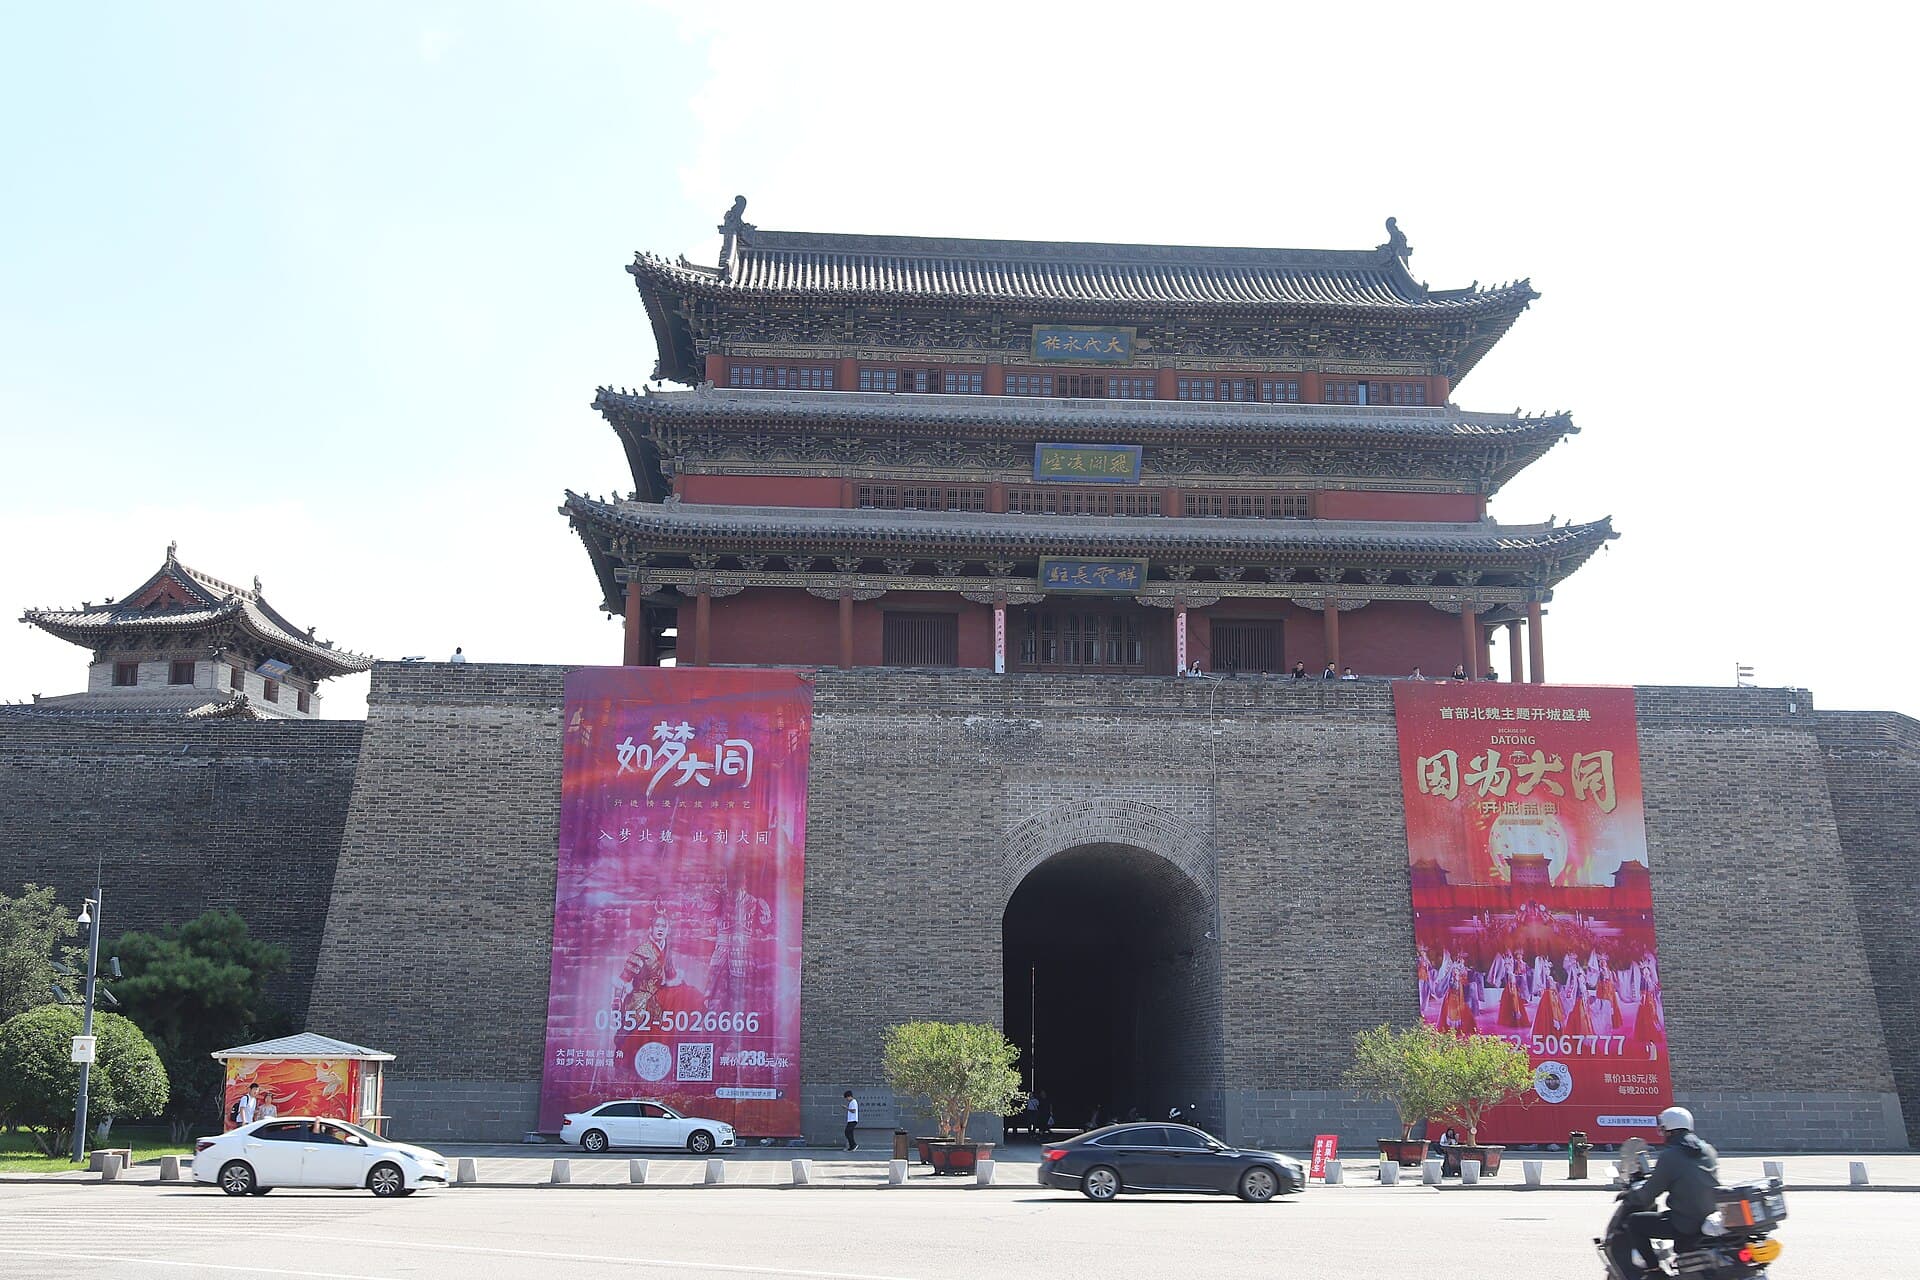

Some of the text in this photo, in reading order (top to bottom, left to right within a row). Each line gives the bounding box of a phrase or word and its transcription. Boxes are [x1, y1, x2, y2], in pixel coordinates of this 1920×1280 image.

[1440, 706, 1592, 722] 首部北魏主题开城盛典
[1490, 735, 1536, 745] DATONG
[615, 720, 754, 797] 如梦大同
[1416, 749, 1617, 814] 因为大同
[598, 829, 769, 845] 入梦北魏 此刻大同
[595, 1010, 760, 1033] 0352-5026666
